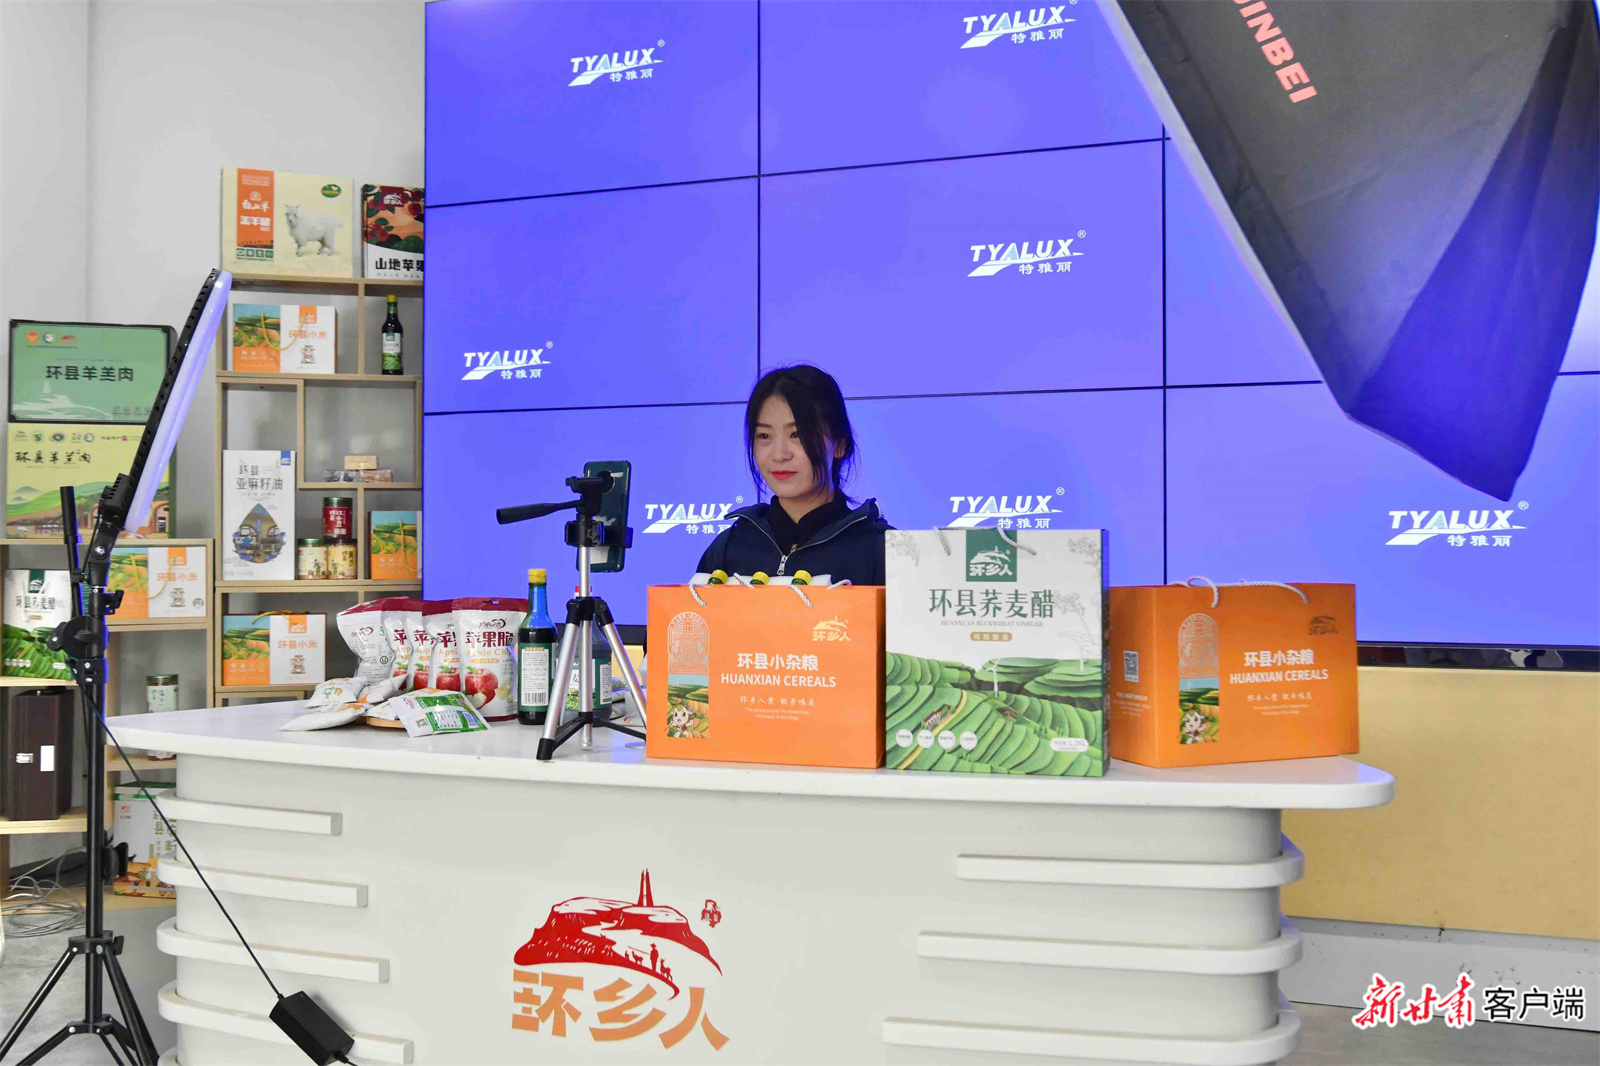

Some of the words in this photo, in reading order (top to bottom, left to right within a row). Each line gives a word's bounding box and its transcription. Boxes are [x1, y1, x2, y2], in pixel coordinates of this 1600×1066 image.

[963, 5, 1066, 34] TYALUX
[1010, 28, 1064, 44] 特雅丽
[1233, 0, 1317, 103] INBEI
[570, 48, 655, 73] TYALUX
[609, 68, 654, 82] 特雅丽
[970, 239, 1074, 262] TYALUX
[375, 257, 424, 272] 山地苹果
[1018, 261, 1073, 275] 特雅丽
[463, 349, 544, 367] TYALUX
[500, 369, 543, 380] 特雅丽
[236, 477, 284, 490] 亚麻籽油
[644, 503, 733, 520] TYALUX
[949, 495, 1053, 513] TYALUX
[997, 517, 1051, 529] 特雅丽
[1388, 510, 1515, 529] TYALUX
[1446, 534, 1513, 547] 特雅丽
[969, 563, 1013, 577] 环乡人
[928, 588, 1055, 619] 环县荞麦醋
[278, 640, 318, 648] 环县小米
[736, 653, 819, 671] 环县小杂粮
[1243, 648, 1315, 668] 环县小杂粮
[721, 673, 781, 687] HUANXIAN
[783, 675, 837, 688] CEREALS
[1229, 671, 1283, 684] HUANXIAN
[1284, 668, 1329, 682] CEREALS
[512, 968, 730, 1051] 环乡人
